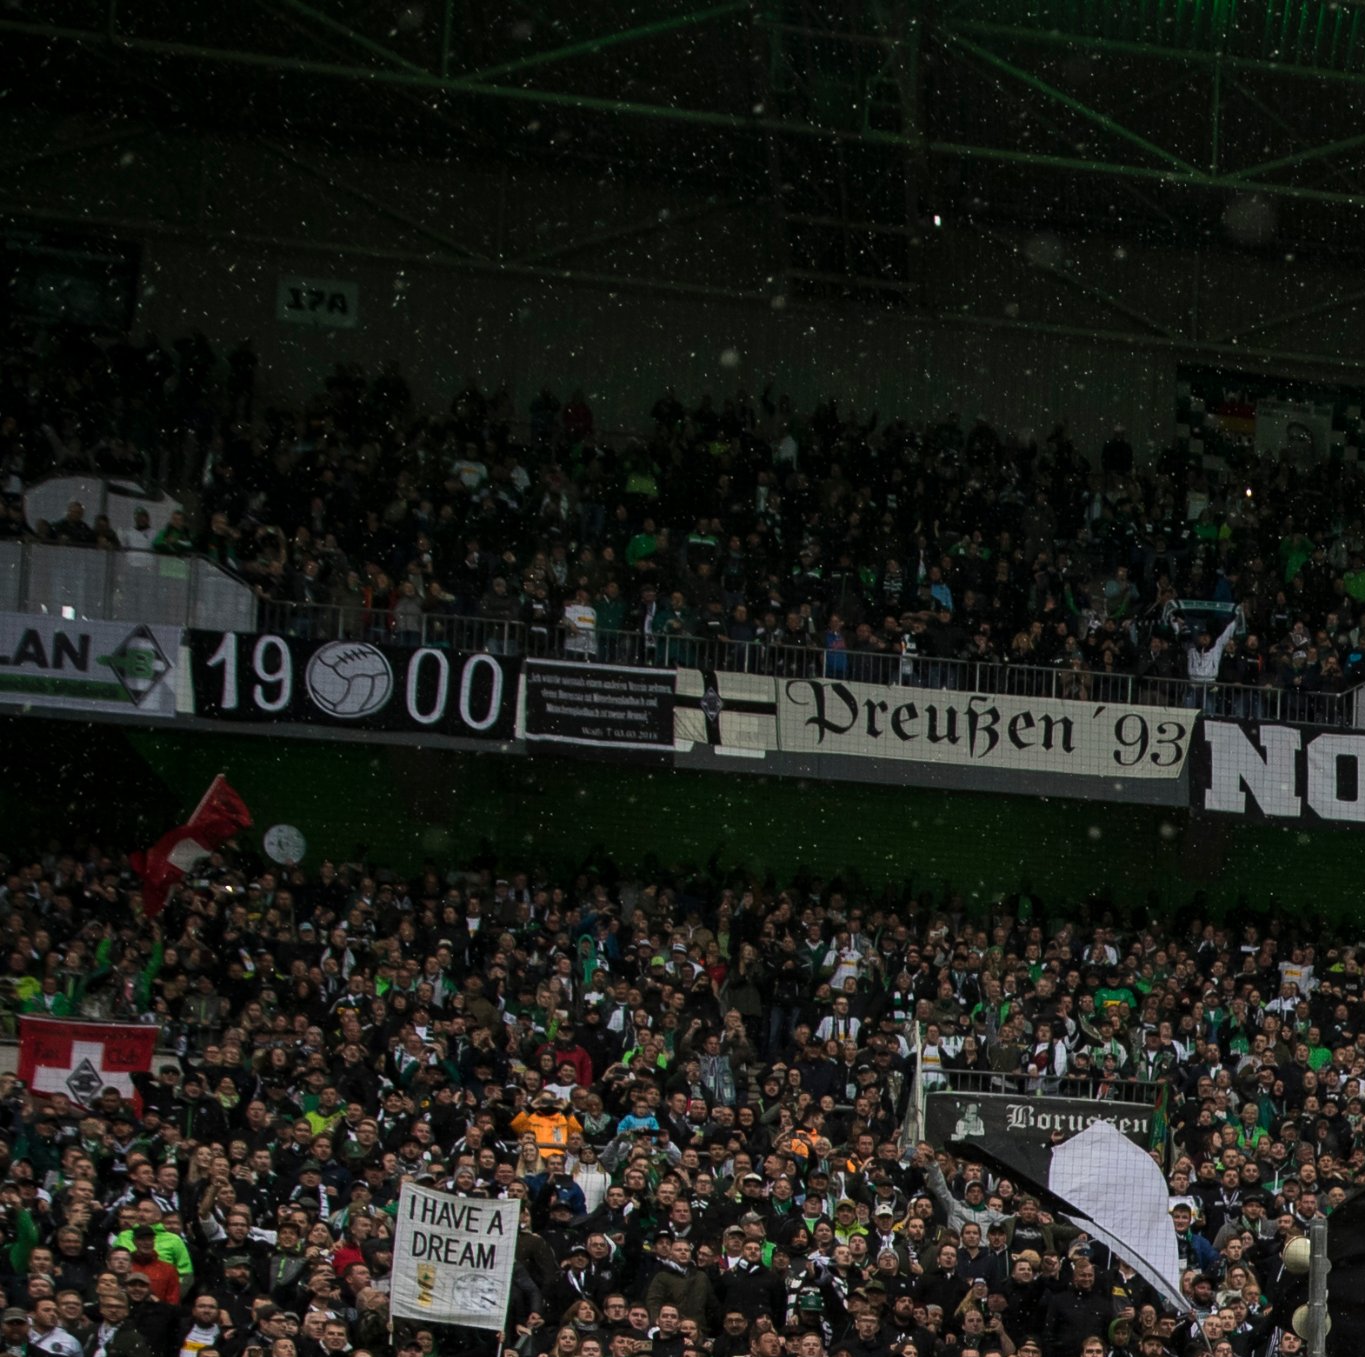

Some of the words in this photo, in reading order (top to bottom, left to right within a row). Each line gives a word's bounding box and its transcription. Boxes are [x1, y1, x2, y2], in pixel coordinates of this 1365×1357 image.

[0, 628, 91, 672] AN
[206, 631, 293, 712] 19
[405, 647, 502, 731] 00
[786, 677, 1076, 758] Preußen
[409, 1194, 417, 1220] I
[421, 1196, 483, 1233] HAVE
[486, 1209, 504, 1236] A
[411, 1230, 496, 1270] DREAM
